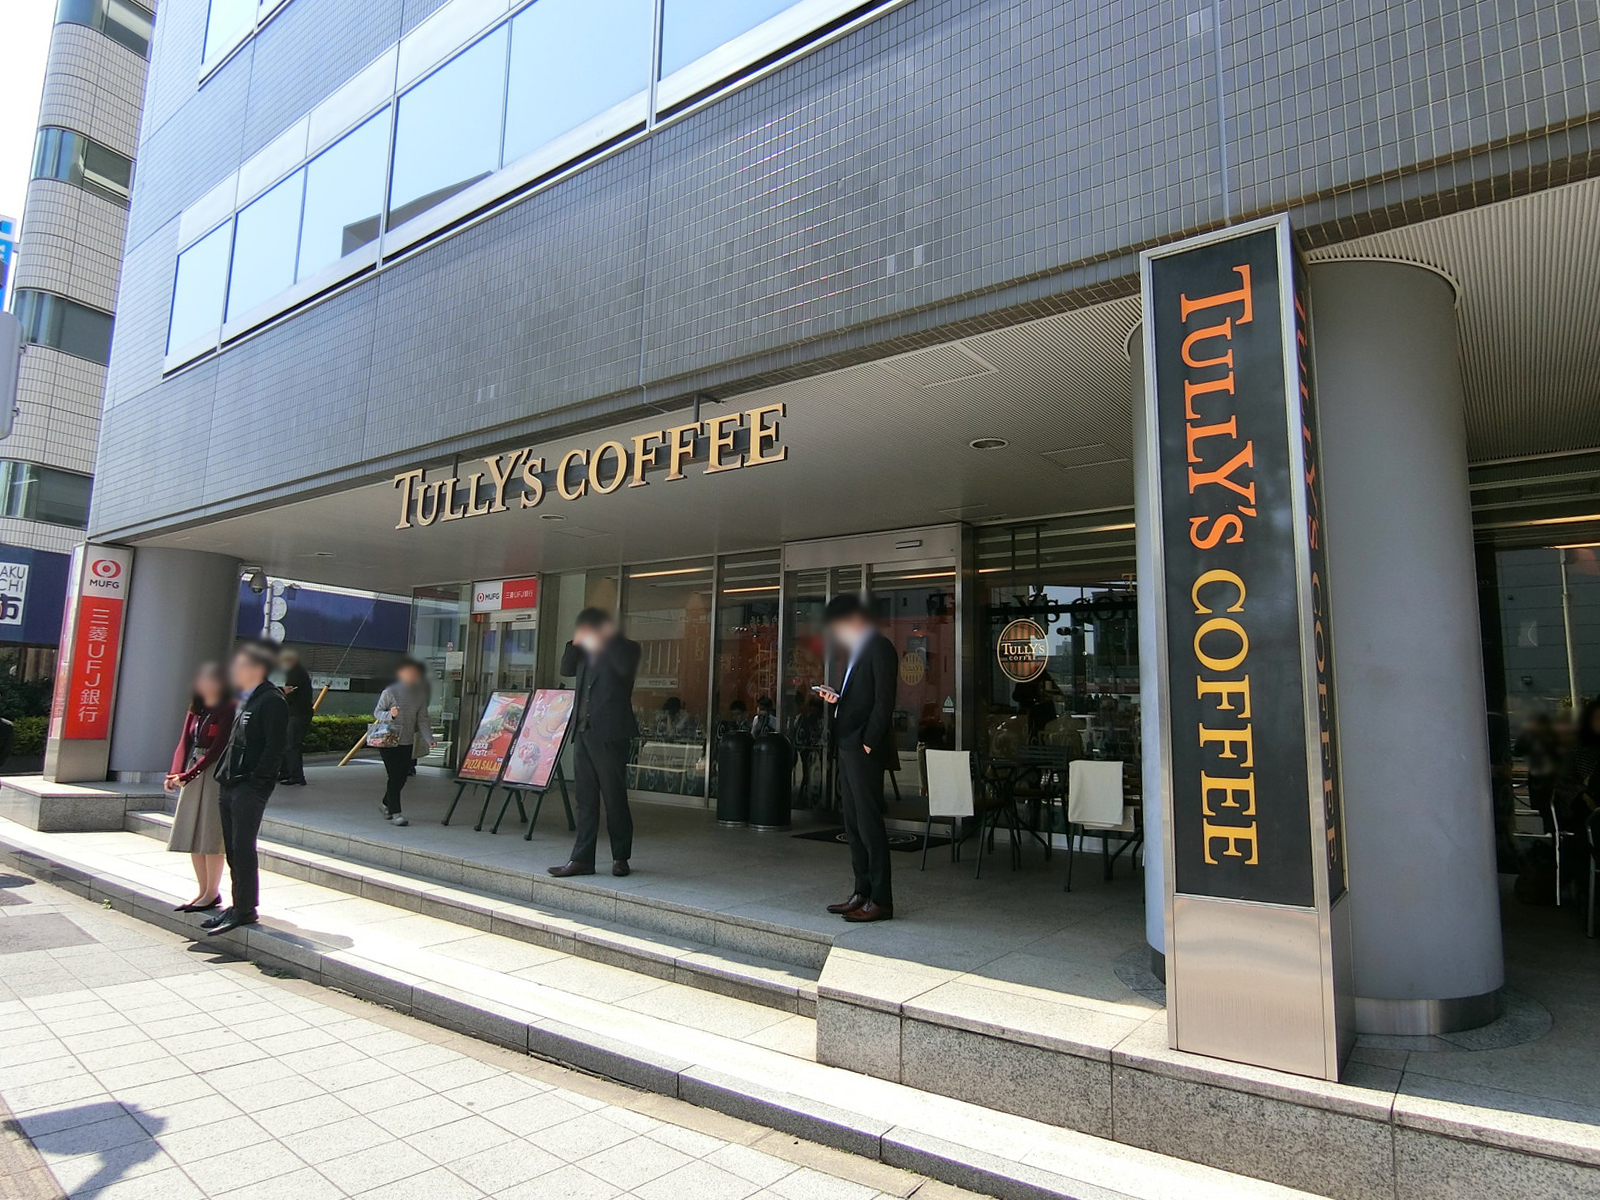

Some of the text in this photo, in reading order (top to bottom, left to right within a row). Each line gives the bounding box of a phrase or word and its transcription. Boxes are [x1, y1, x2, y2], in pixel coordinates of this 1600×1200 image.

[393, 402, 789, 530] TULLY'S COFFEE
[1180, 263, 1260, 867] TULLY'S COFFEE
[89, 579, 120, 589] MUFG
[485, 592, 500, 601] MUFG
[1001, 643, 1045, 655] TULLY'S
[78, 608, 110, 723] 三菱UFJ銀行
[463, 758, 481, 770] PIZZA
